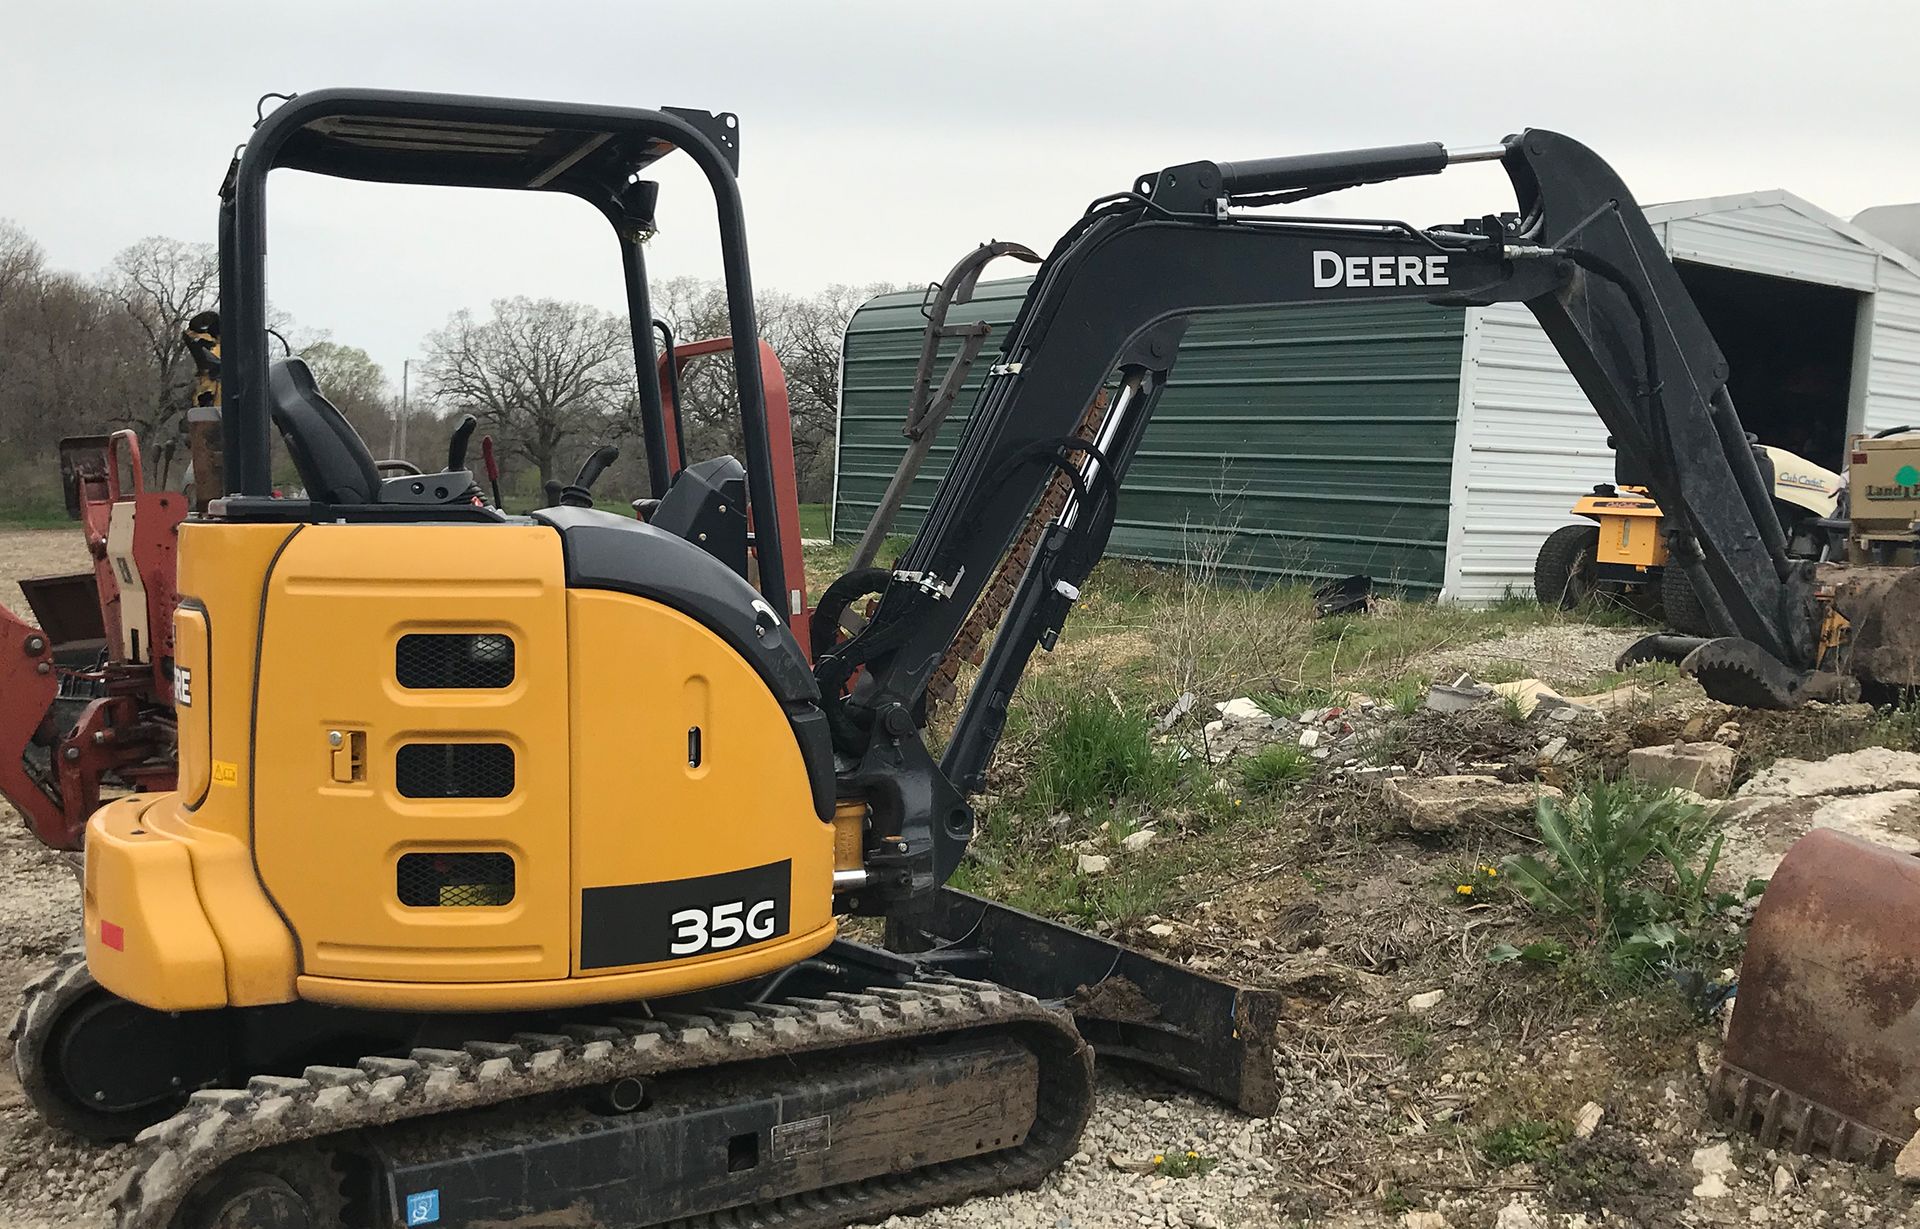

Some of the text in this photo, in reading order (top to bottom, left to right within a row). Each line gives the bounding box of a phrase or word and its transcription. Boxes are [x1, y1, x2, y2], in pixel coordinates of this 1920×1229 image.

[1313, 250, 1449, 288] DEERE
[1865, 485, 1902, 497] Land
[671, 900, 774, 954] 35G
